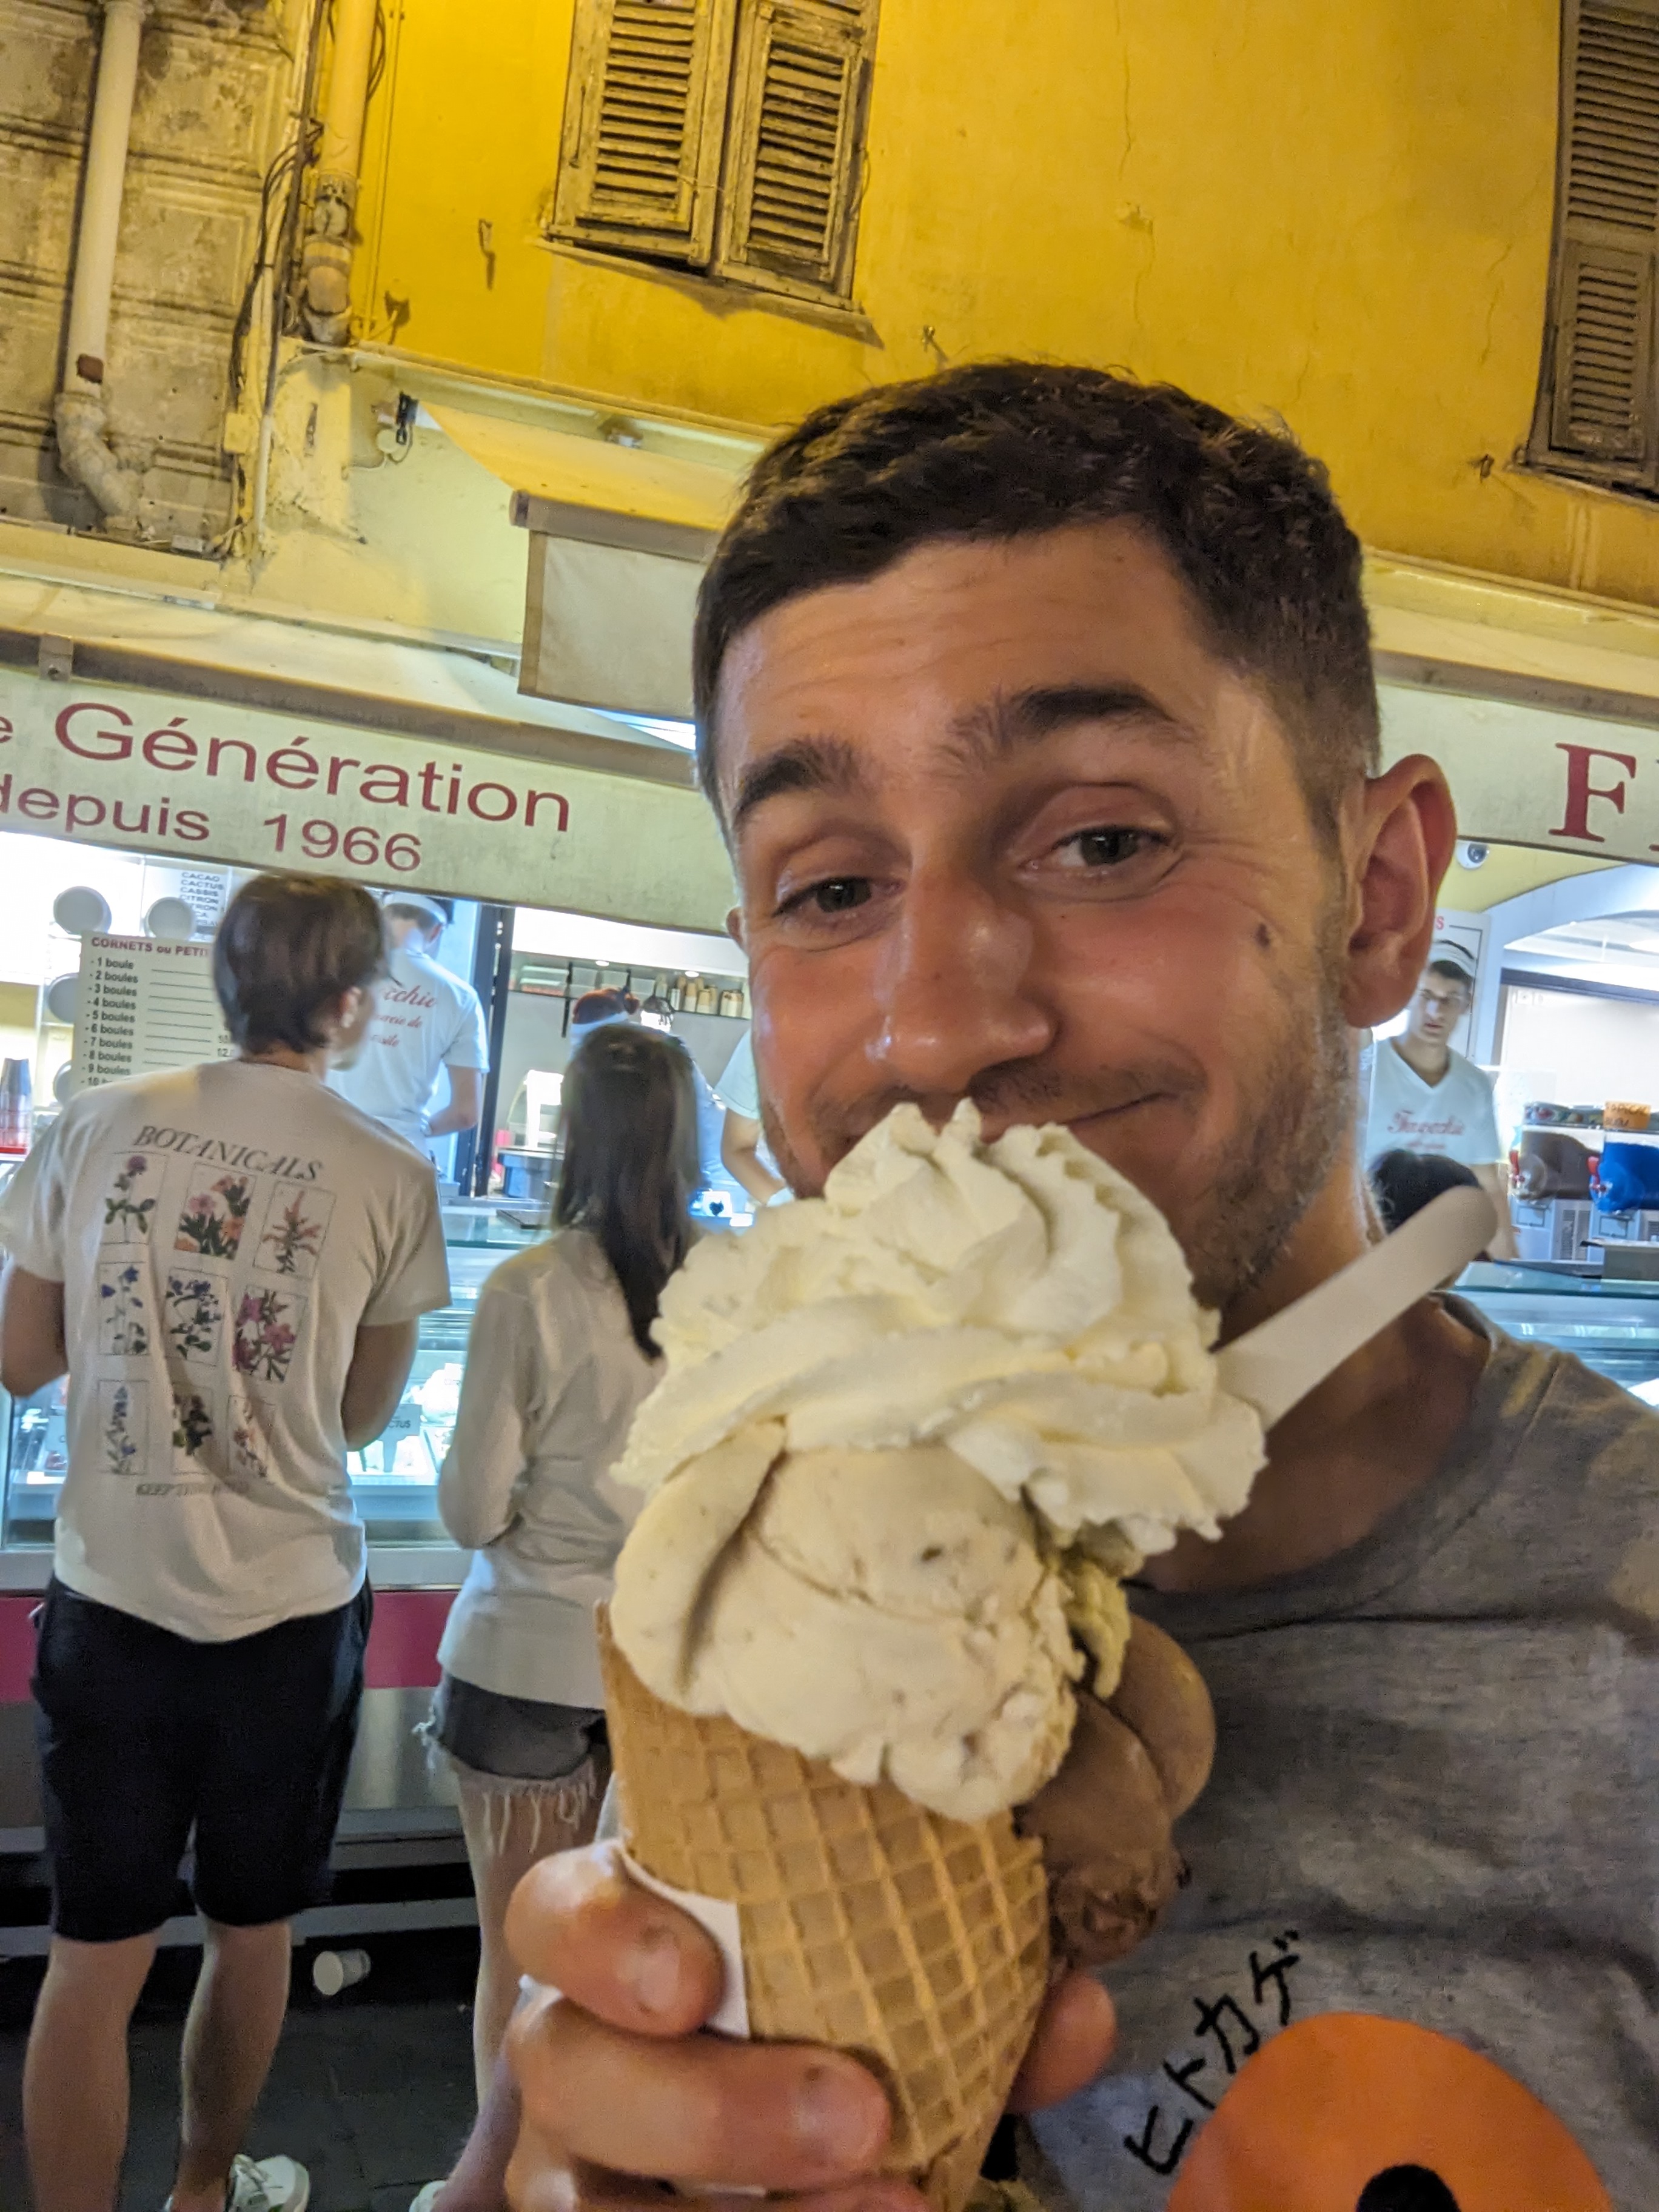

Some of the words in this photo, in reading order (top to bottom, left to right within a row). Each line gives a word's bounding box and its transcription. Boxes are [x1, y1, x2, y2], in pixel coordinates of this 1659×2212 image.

[55, 702, 570, 832] Génération
[1548, 742, 1659, 852] F
[263, 814, 422, 871] 1966
[182, 872, 220, 882] CACAO
[181, 879, 224, 891] CACTUS
[91, 937, 153, 952] CORNETS
[156, 945, 171, 954] ou
[97, 956, 102, 967] 1
[106, 957, 134, 970] boule
[95, 970, 102, 980] 2
[104, 971, 138, 984] boules
[94, 983, 101, 993] 3
[103, 984, 137, 997] boules
[93, 997, 99, 1007] 4
[102, 997, 136, 1010] boules
[92, 1010, 98, 1019] 5
[101, 1011, 136, 1024] boules
[100, 1024, 134, 1036] boules
[90, 1036, 96, 1047] 7
[99, 1036, 132, 1050] boules
[98, 1050, 132, 1063] boules
[133, 1125, 323, 1180] BOTANICALS
[1123, 1928, 1301, 2176] ヒトカゲ
